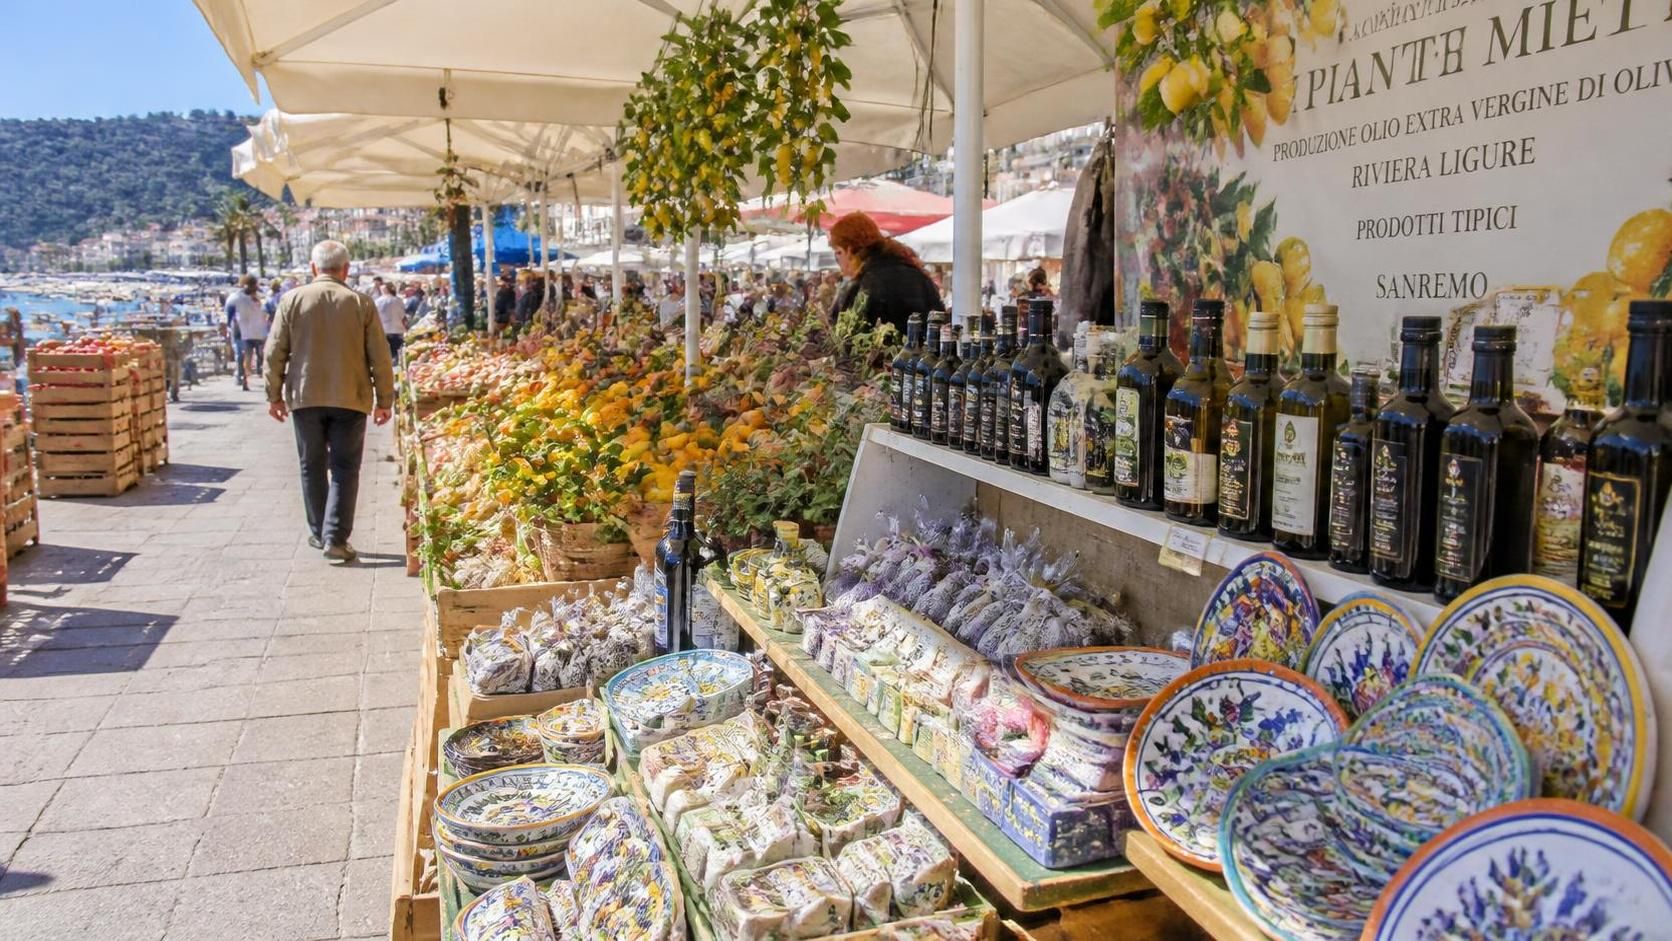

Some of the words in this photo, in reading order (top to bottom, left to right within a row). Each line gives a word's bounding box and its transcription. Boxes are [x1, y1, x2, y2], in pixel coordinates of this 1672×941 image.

[1272, 126, 1358, 162] PRODUZIONE
[1360, 117, 1400, 143] OLIO
[1405, 103, 1464, 135] EXTRA
[1471, 81, 1569, 121] VERGINE
[1576, 73, 1607, 102] DI
[1351, 155, 1432, 188] RIVIERA
[1439, 136, 1536, 177] LIGURE
[1356, 211, 1445, 240] PRODOTTI
[1451, 205, 1518, 233] TIPICI
[1376, 271, 1488, 299] SANREMO
